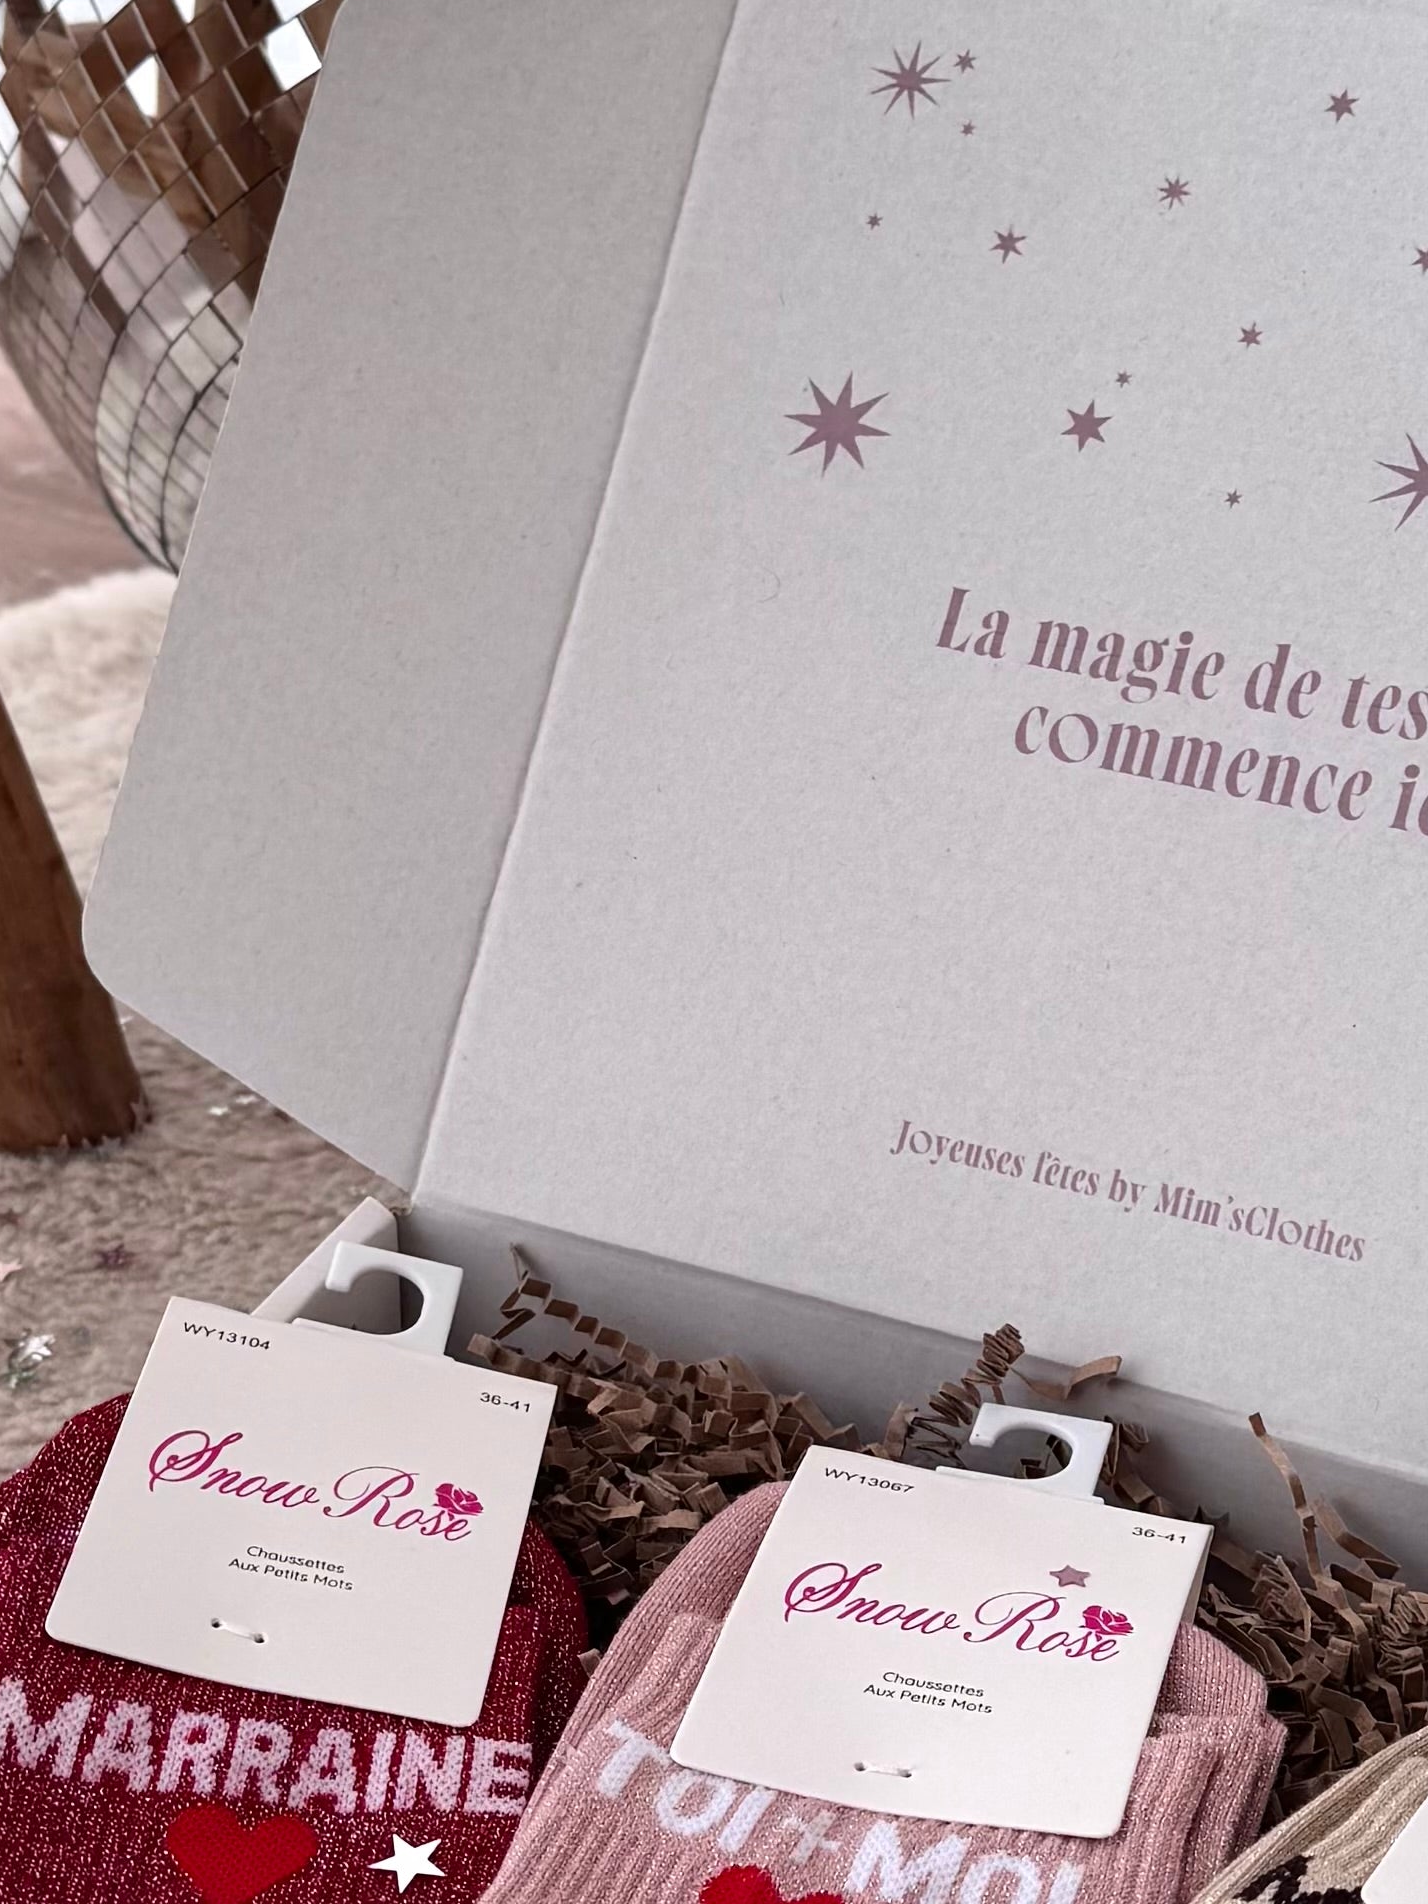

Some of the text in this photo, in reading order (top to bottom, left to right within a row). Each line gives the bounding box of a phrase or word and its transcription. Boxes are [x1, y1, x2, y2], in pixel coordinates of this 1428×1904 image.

[936, 586, 1009, 660] La
[1028, 619, 1225, 704] magie
[1244, 643, 1321, 720] de
[1015, 705, 1372, 821] commence
[889, 1119, 1026, 1178] Joyeuses
[1032, 1151, 1100, 1196] fêtes
[1107, 1168, 1147, 1213] by
[183, 1321, 271, 1351] WY13104
[479, 1391, 532, 1413] 36-41
[148, 1429, 473, 1542] Snow Rose
[824, 1467, 915, 1493] WY13067
[1131, 1526, 1187, 1545] 36-41
[228, 1557, 353, 1591] Aux Petits Mots
[246, 1545, 345, 1574] Chaussettes
[783, 1562, 1120, 1662] Snow Rose
[862, 1684, 993, 1714] Aux Petits Mots
[882, 1671, 984, 1698] Chaussettes
